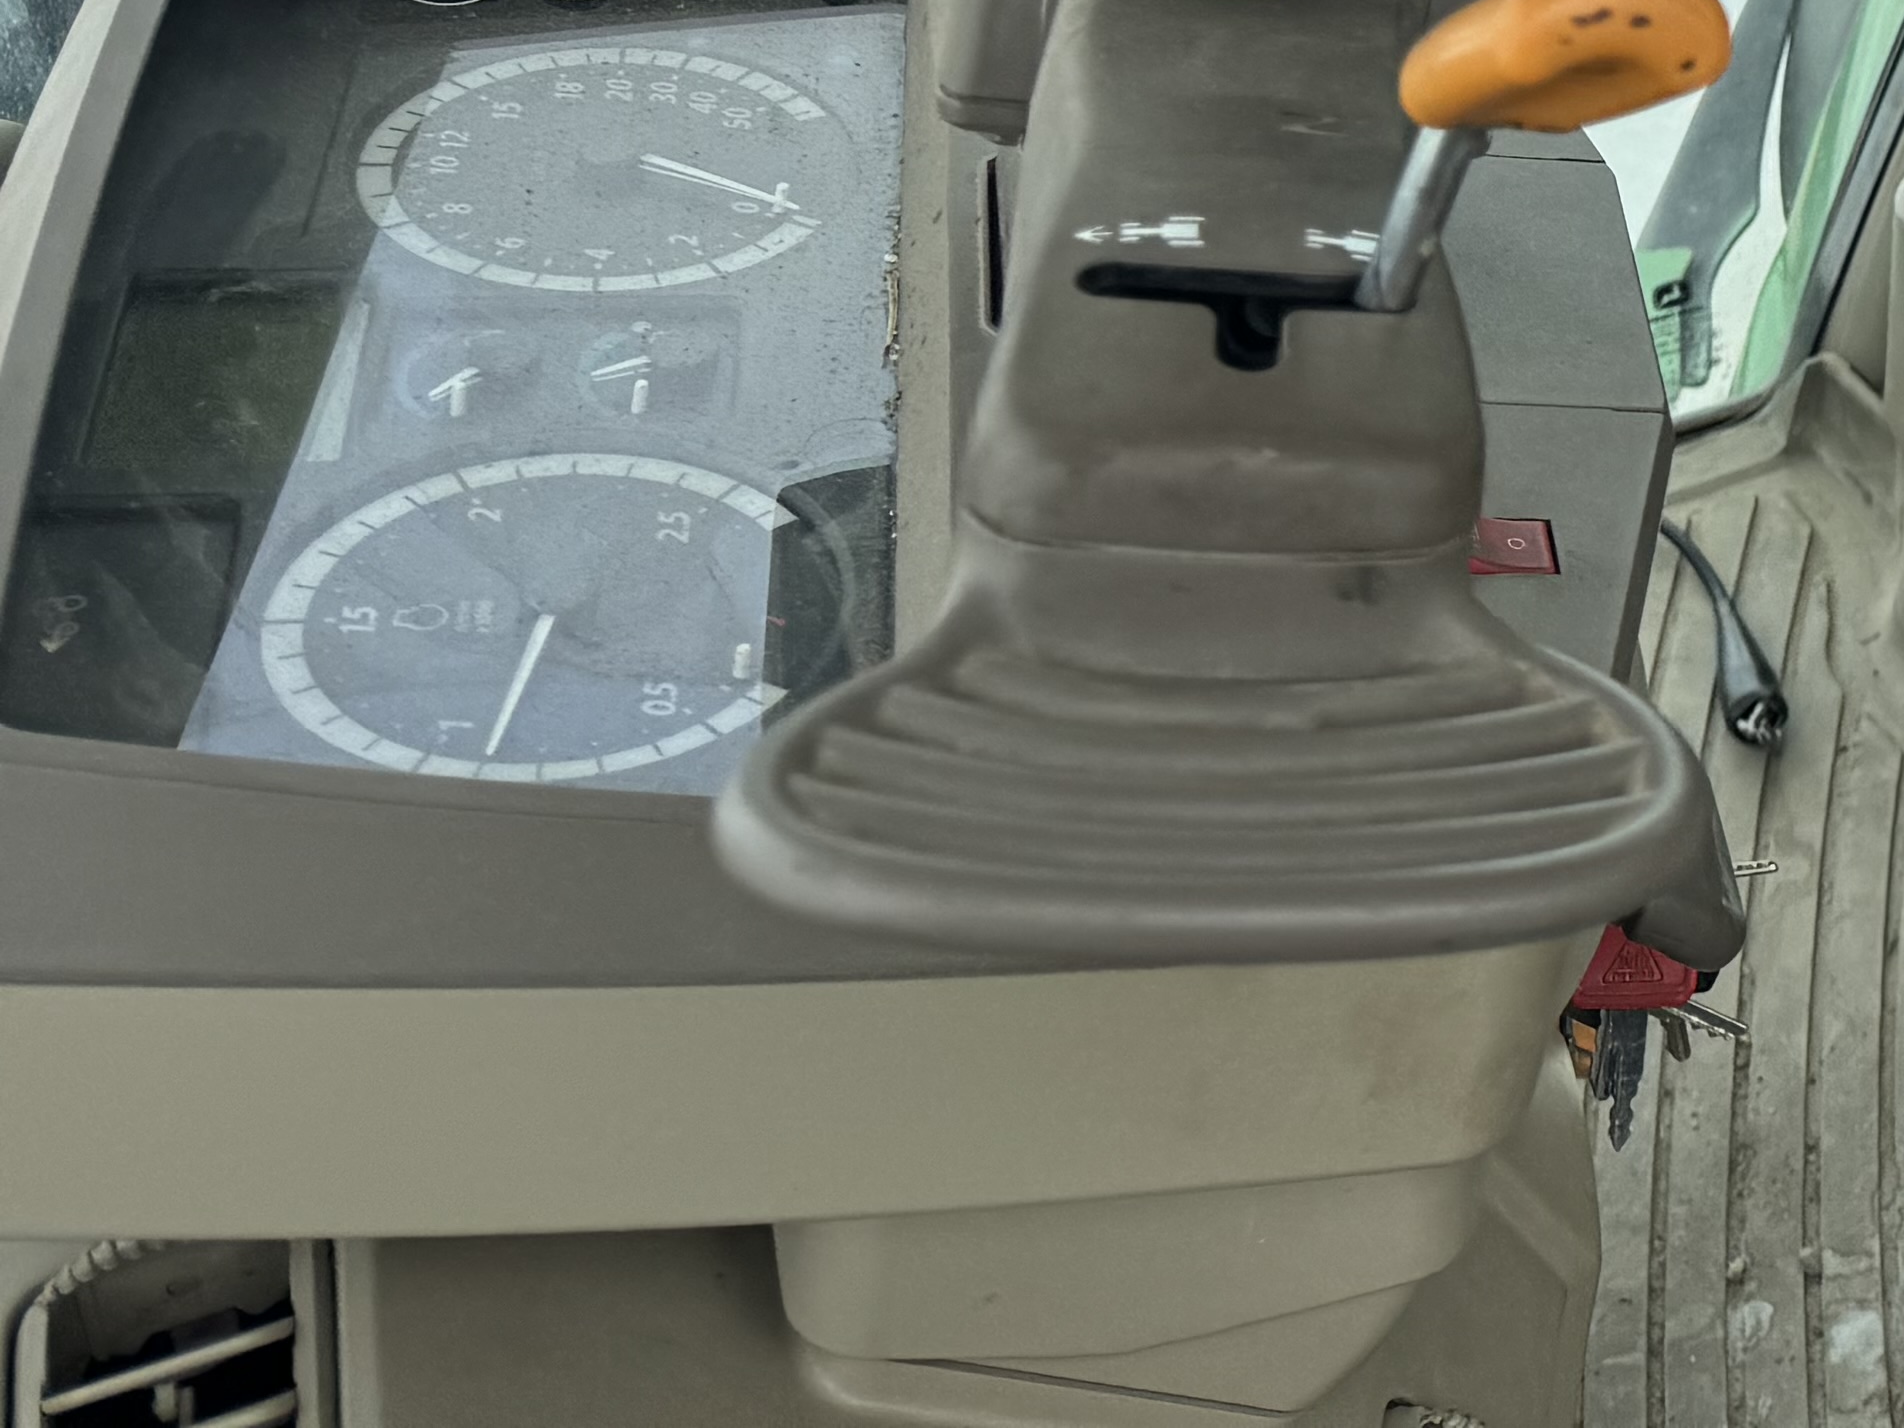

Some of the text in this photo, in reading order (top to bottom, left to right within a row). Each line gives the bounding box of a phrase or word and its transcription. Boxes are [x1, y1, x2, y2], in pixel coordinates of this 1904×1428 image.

[554, 81, 585, 100] 18
[605, 77, 635, 101] 20
[649, 81, 679, 105] 30
[492, 101, 523, 119] 15
[688, 91, 718, 114] 40
[722, 107, 753, 129] 50
[439, 130, 470, 148] 12
[429, 156, 459, 175] 10
[442, 202, 473, 214] 8
[732, 202, 760, 214] 0
[495, 237, 525, 249] 6
[668, 234, 699, 246] 2
[584, 247, 615, 261] 4
[468, 507, 503, 522] 2
[657, 511, 691, 543] 2.5
[641, 682, 678, 716] 0.5
[437, 720, 473, 734] 1
